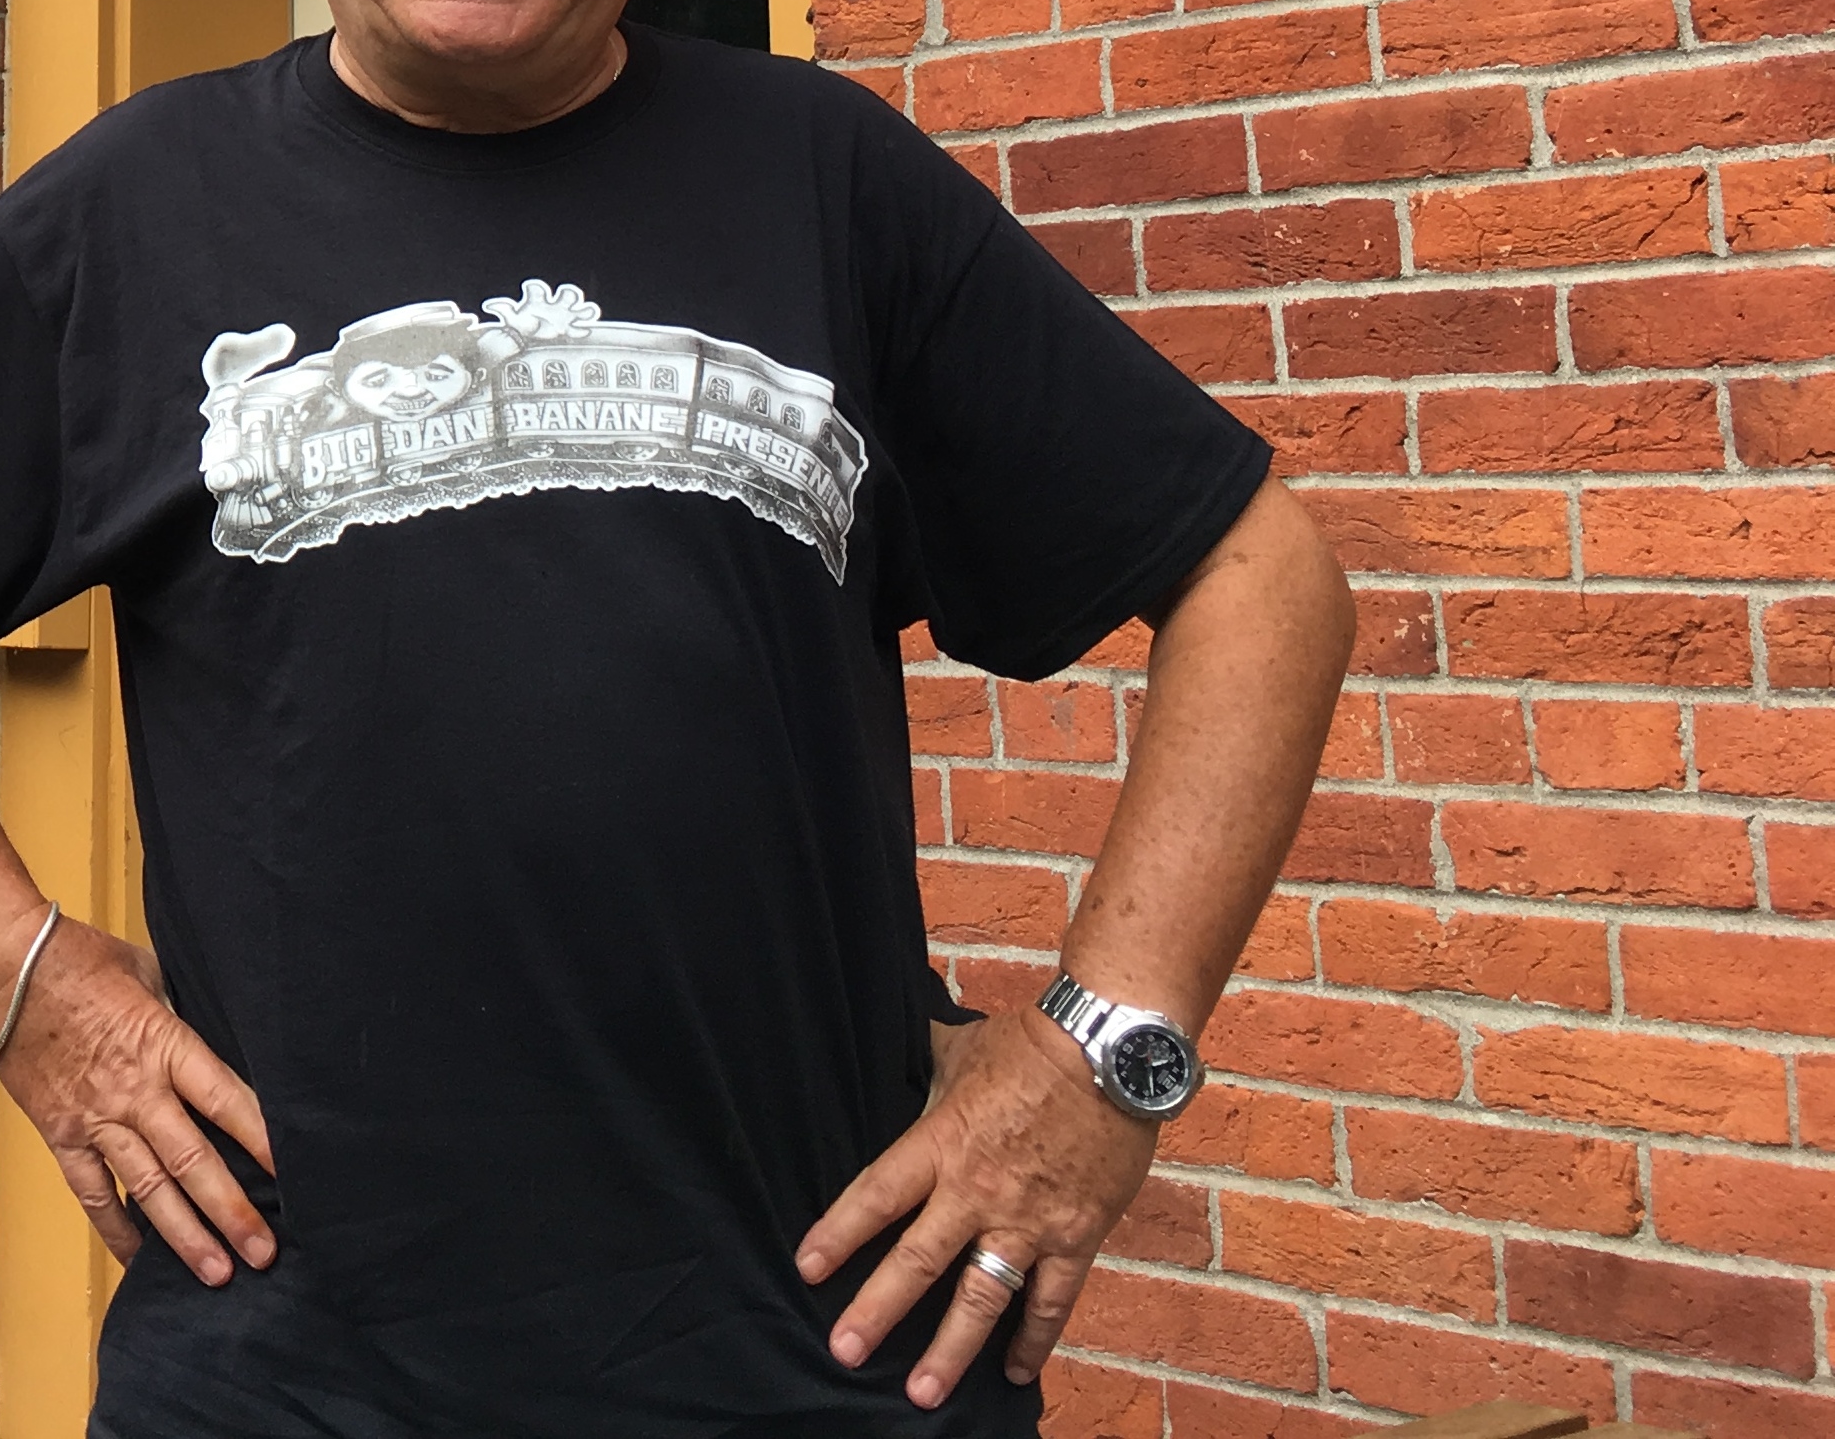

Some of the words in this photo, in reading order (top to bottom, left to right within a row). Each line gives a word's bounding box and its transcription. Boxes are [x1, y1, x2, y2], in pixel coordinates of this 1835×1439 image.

[301, 425, 375, 489] BIG
[393, 408, 489, 454] DAN
[513, 400, 678, 433] BANANE
